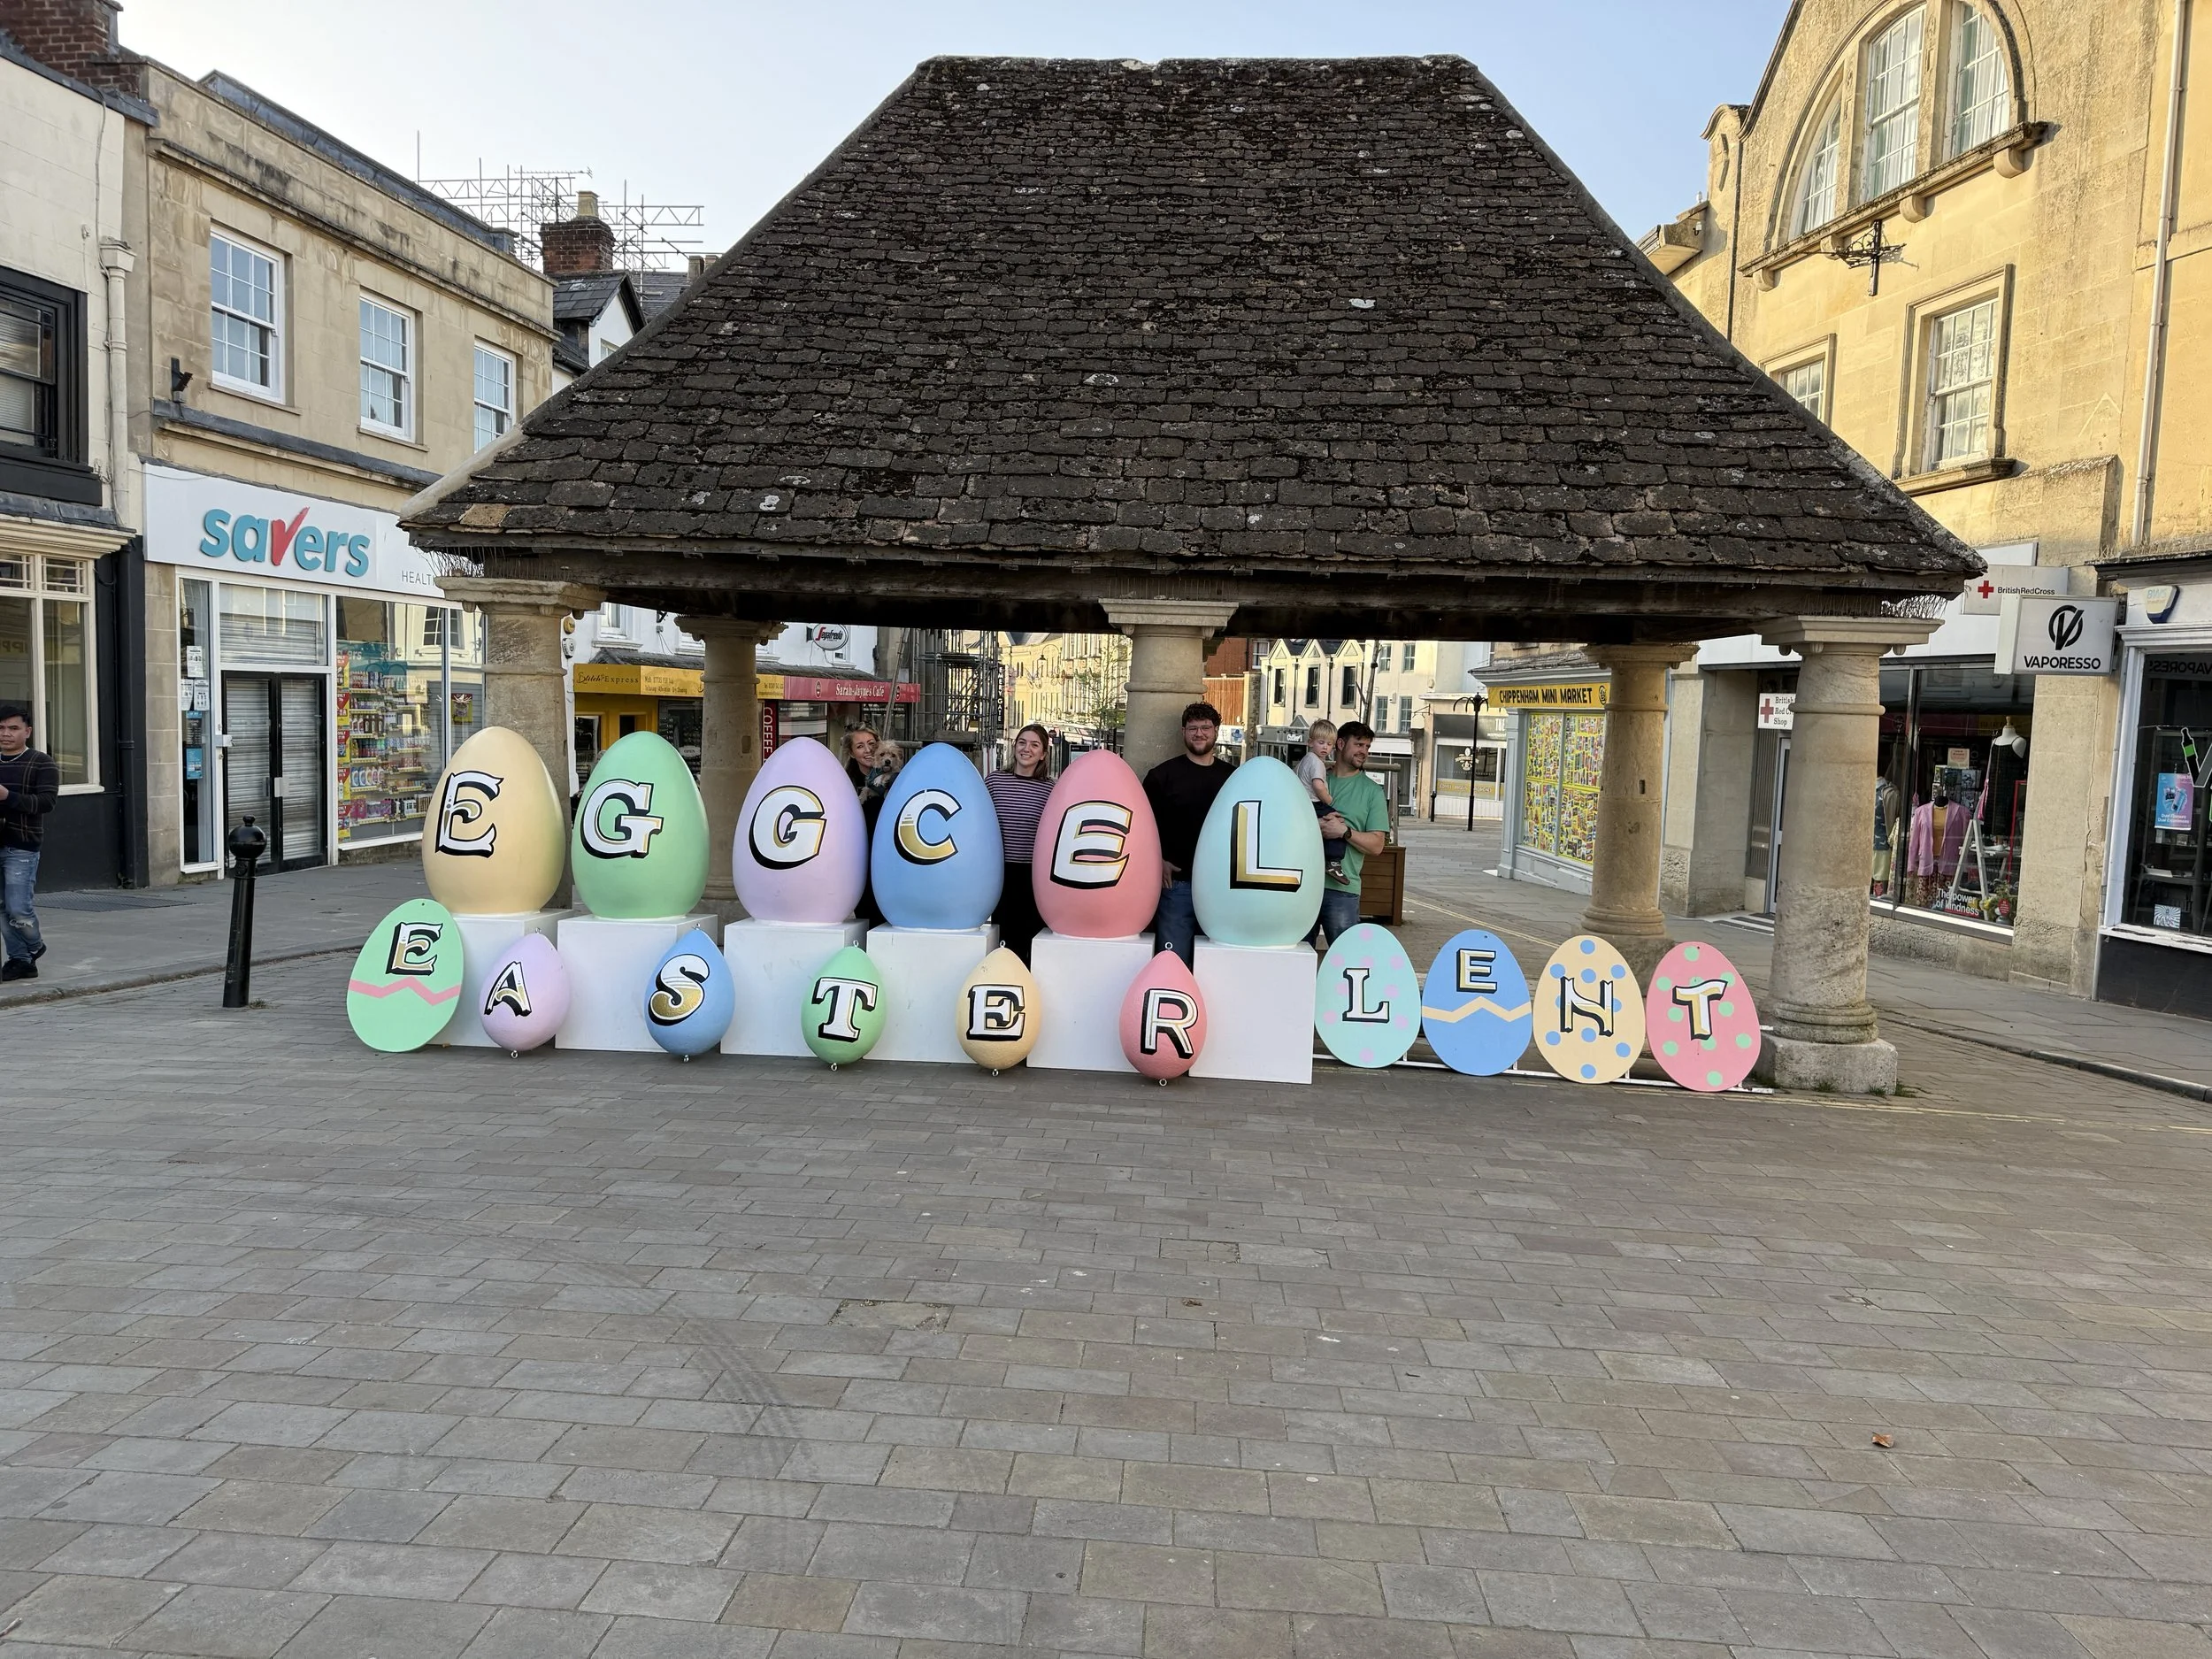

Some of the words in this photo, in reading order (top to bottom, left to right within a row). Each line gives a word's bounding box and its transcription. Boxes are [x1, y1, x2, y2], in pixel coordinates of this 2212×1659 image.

[200, 506, 371, 577] savers
[401, 570, 434, 586] HEALT
[2024, 655, 2101, 670] VAPORESSO
[604, 675, 639, 684] Express
[835, 683, 872, 699] Sarah-Jayne's
[872, 684, 885, 697] Café
[1499, 689, 1540, 704] CHIPPENHAM
[1541, 688, 1557, 703] MINI
[1560, 687, 1593, 704] MARKET
[1773, 717, 1788, 727] Shop
[1937, 887, 1950, 900] The
[1952, 893, 1977, 904] power
[1936, 898, 1945, 909] of
[1945, 899, 1980, 917] kindness
